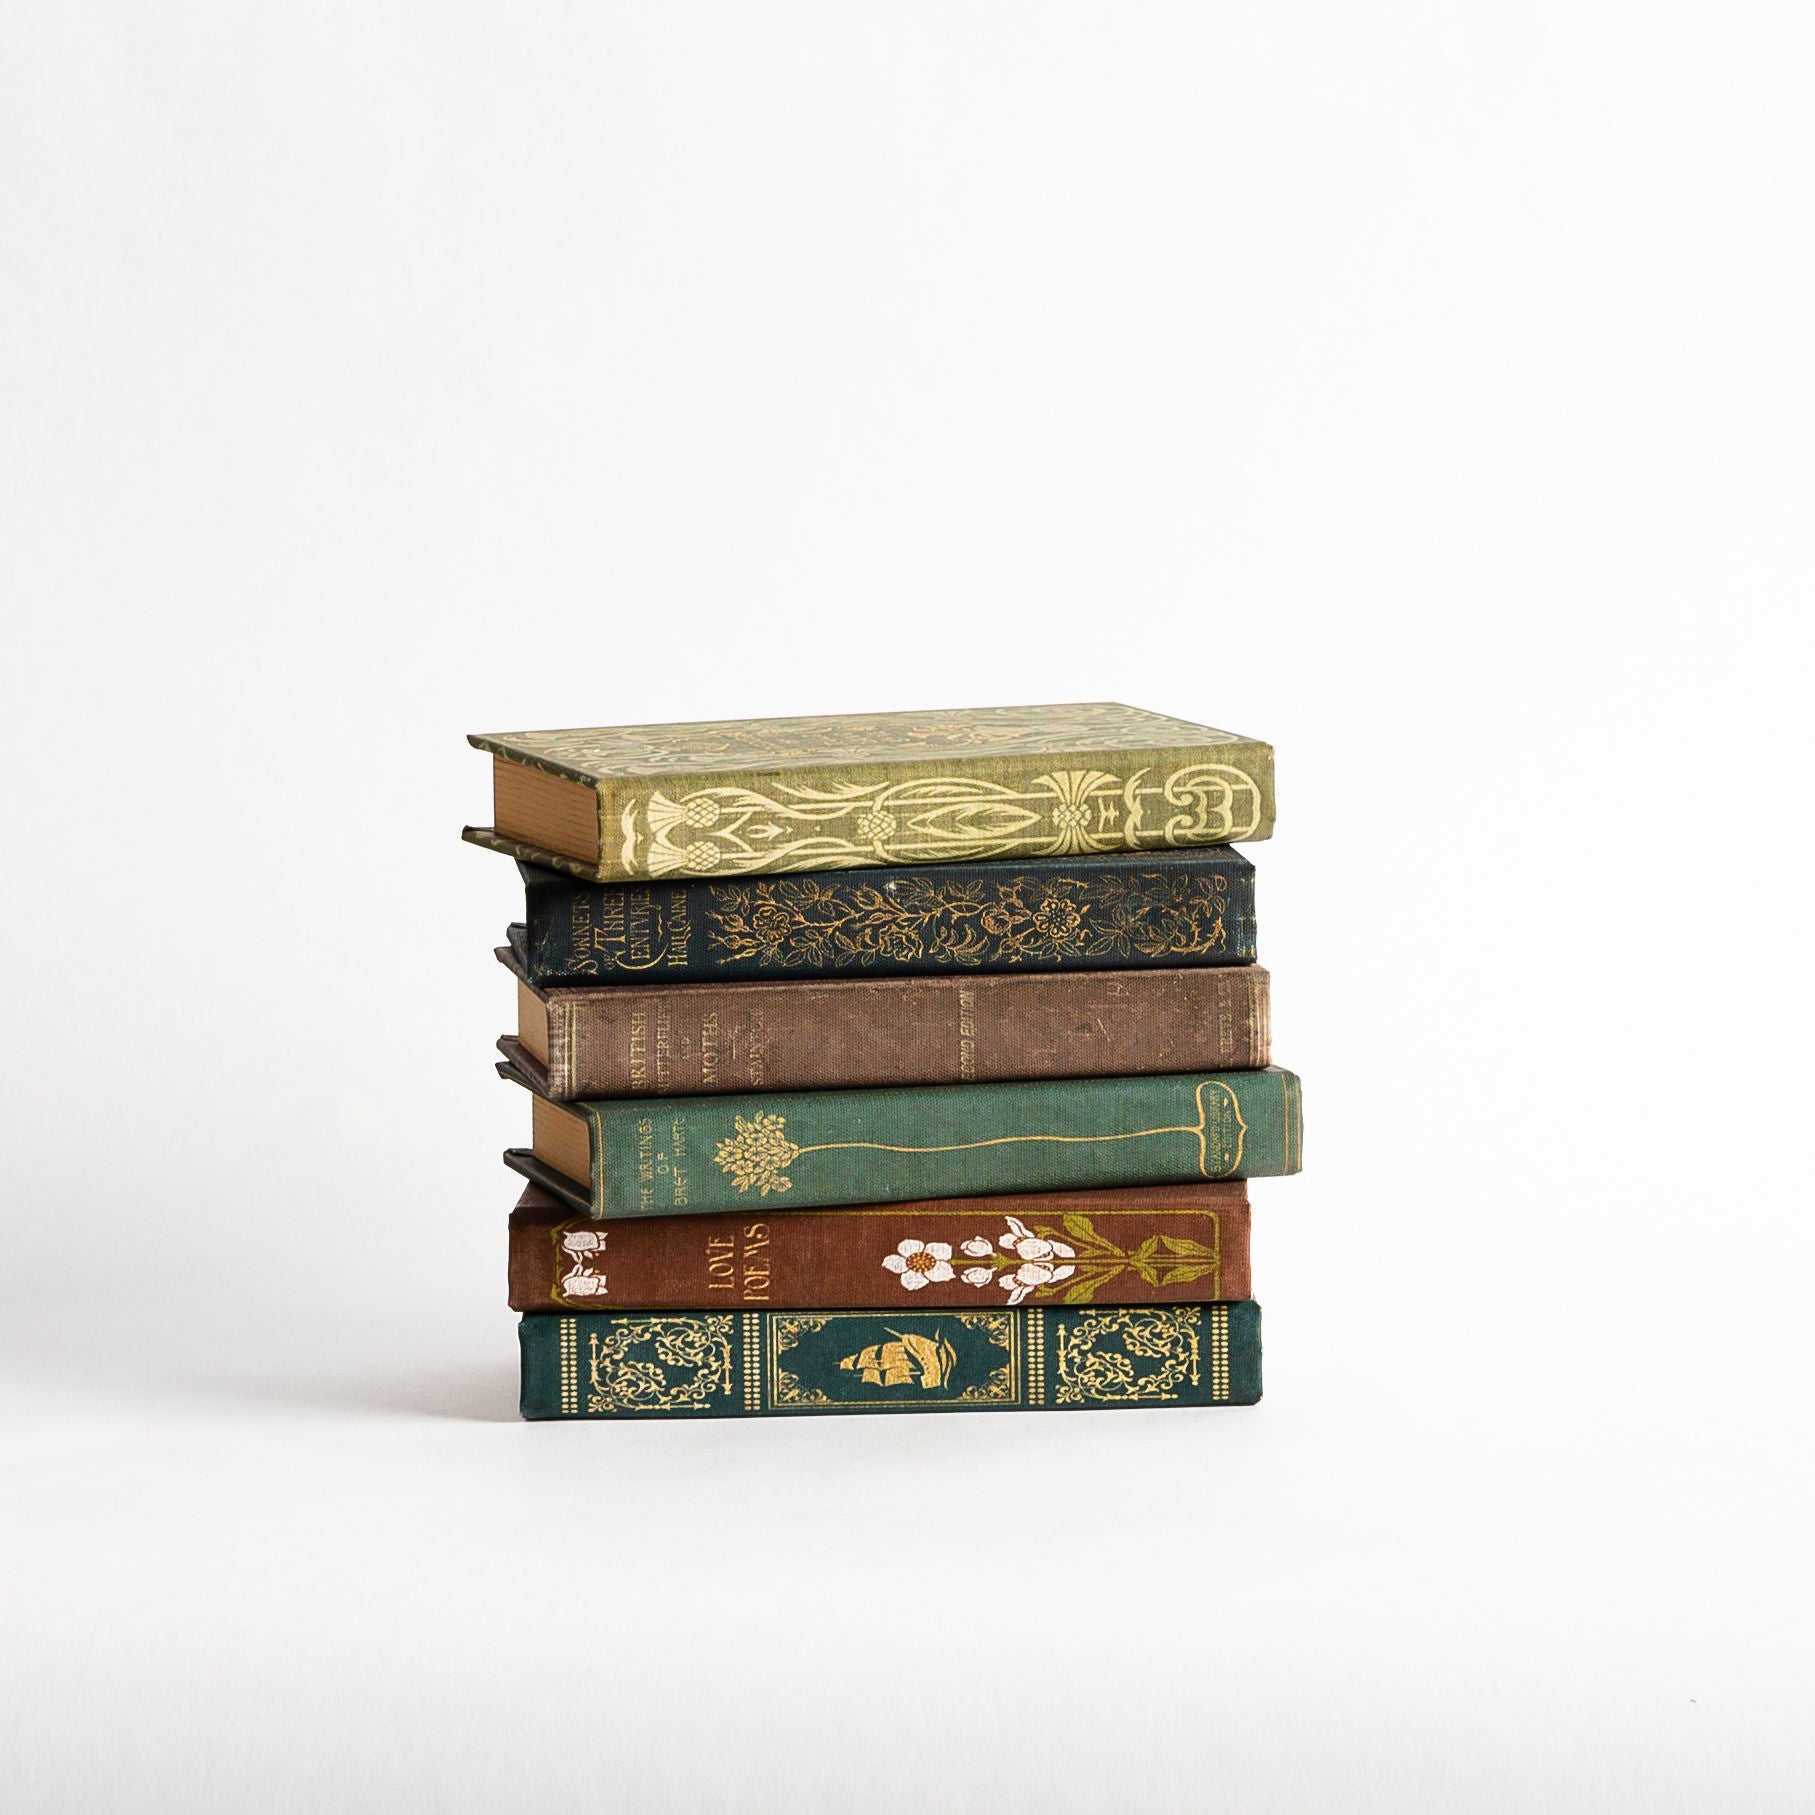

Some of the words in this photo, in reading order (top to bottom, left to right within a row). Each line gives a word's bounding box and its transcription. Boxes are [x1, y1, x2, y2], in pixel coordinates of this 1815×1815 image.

[631, 1012, 646, 1090] BRITISH
[702, 1012, 718, 1088] MOTHS
[638, 1118, 653, 1180] WRITINGS
[657, 1152, 669, 1174] OF
[673, 1167, 688, 1205] BRET
[706, 1235, 735, 1289] LOVE
[743, 1223, 770, 1300] POEMS
